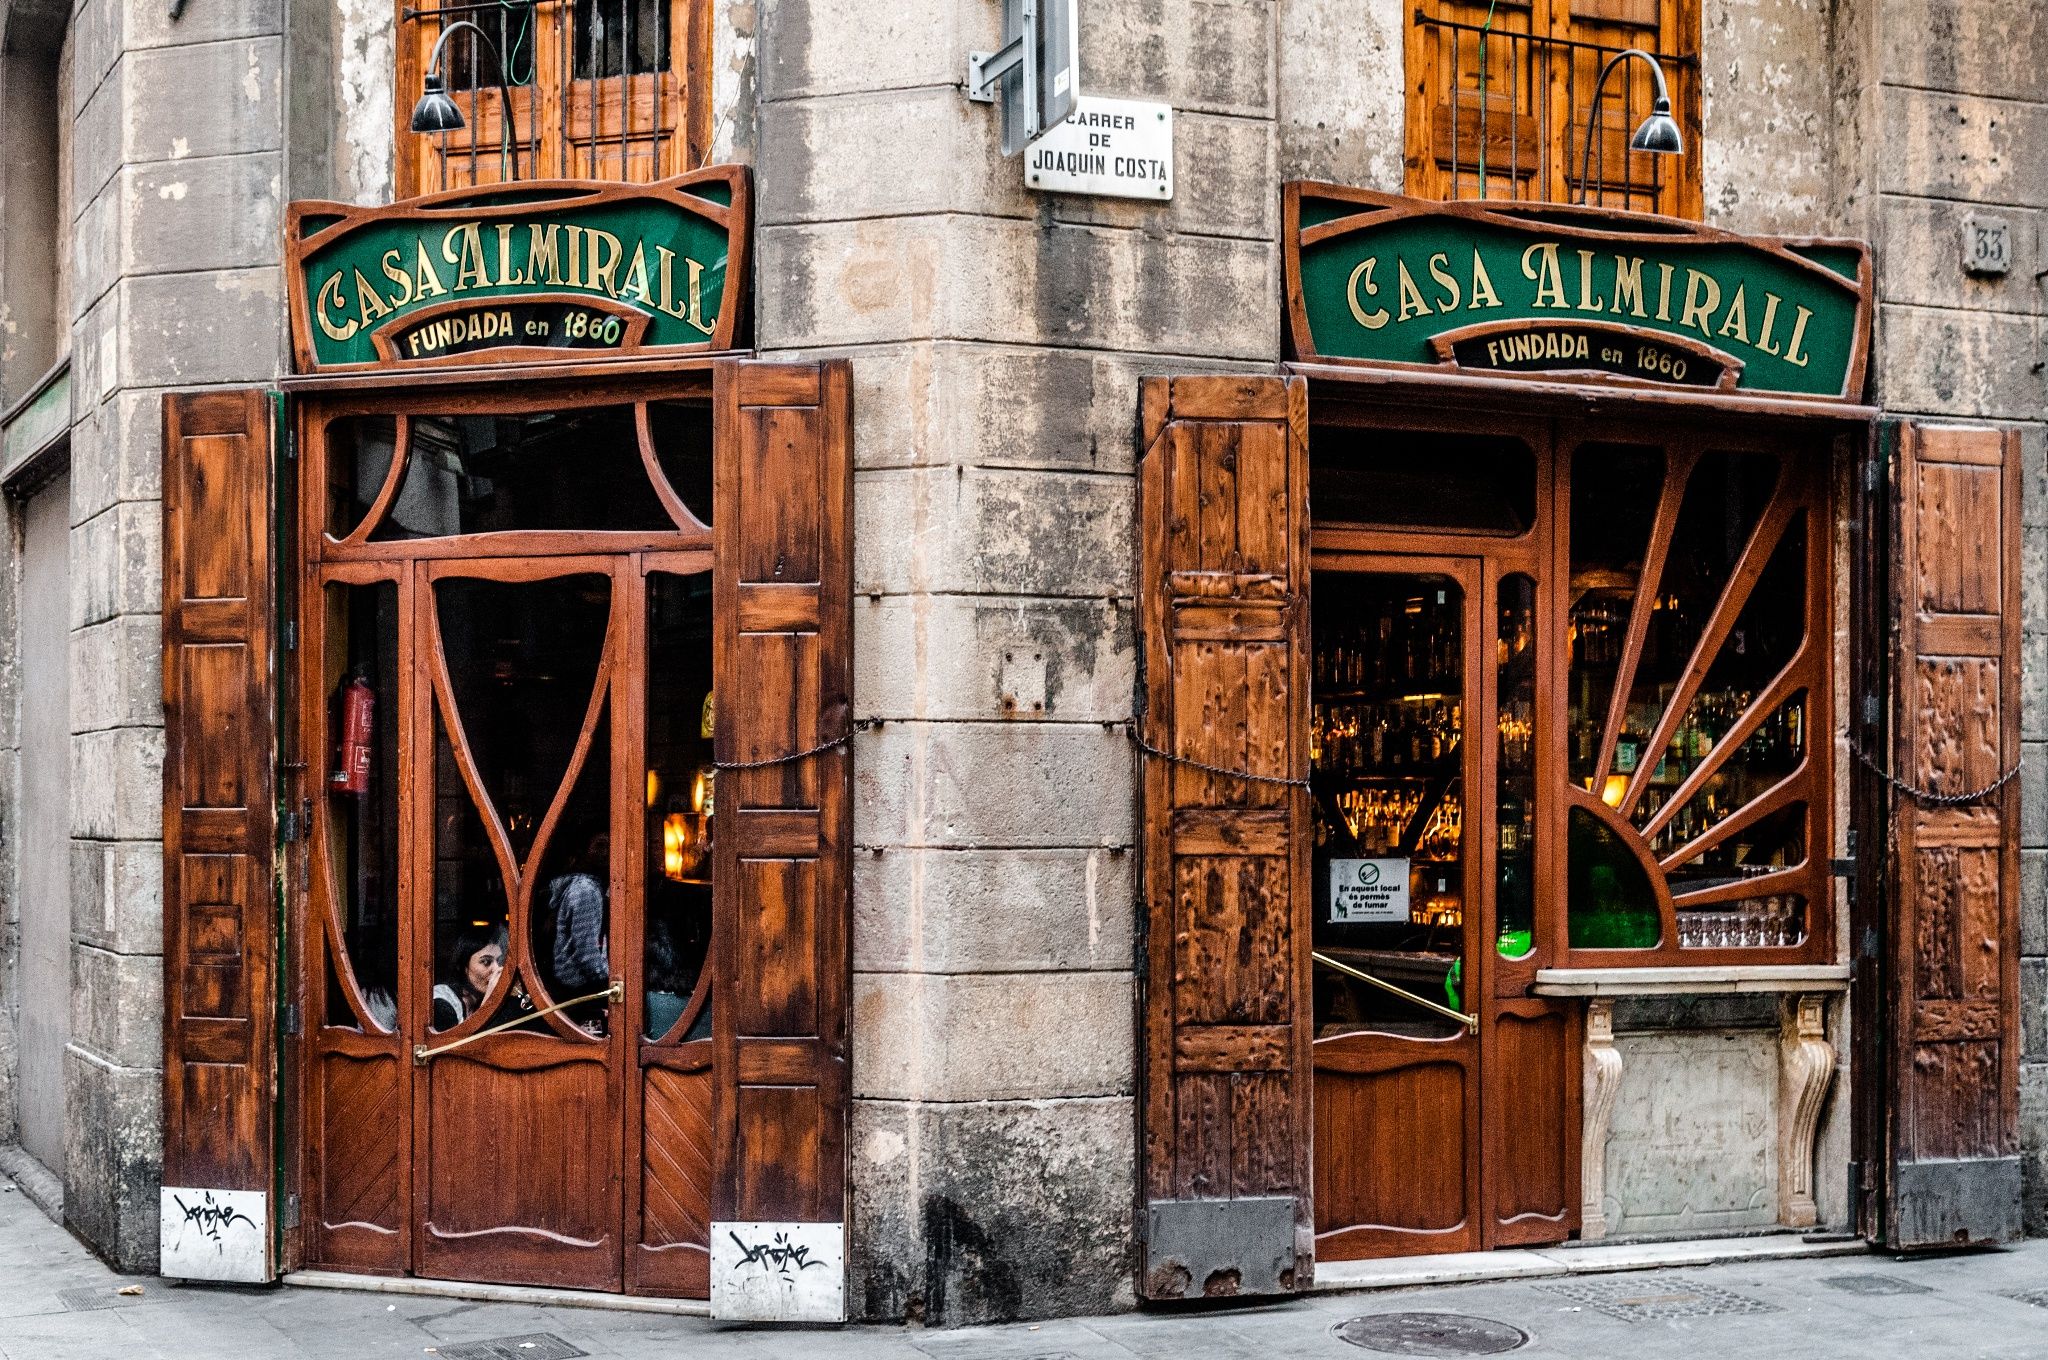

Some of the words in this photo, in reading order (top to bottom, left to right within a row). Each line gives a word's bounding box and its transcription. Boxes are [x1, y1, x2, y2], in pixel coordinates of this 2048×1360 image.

[1066, 112, 1135, 130] CARRER
[1089, 133, 1111, 147] DE
[1115, 157, 1167, 180] COSTA
[1975, 228, 2003, 261] 33
[316, 235, 448, 341] CASA
[442, 221, 717, 336] ALMIRALL
[1347, 247, 1503, 331] CASA
[1522, 241, 1815, 367] ALMIRALL
[408, 311, 514, 357] FUNDADA
[525, 319, 549, 337] en
[564, 311, 621, 344] 1860
[1486, 335, 1589, 366] FUNDADA
[1601, 346, 1623, 365] en
[1637, 347, 1687, 381] 1860
[1351, 885, 1378, 893] aquest
[1360, 893, 1390, 901] permès
